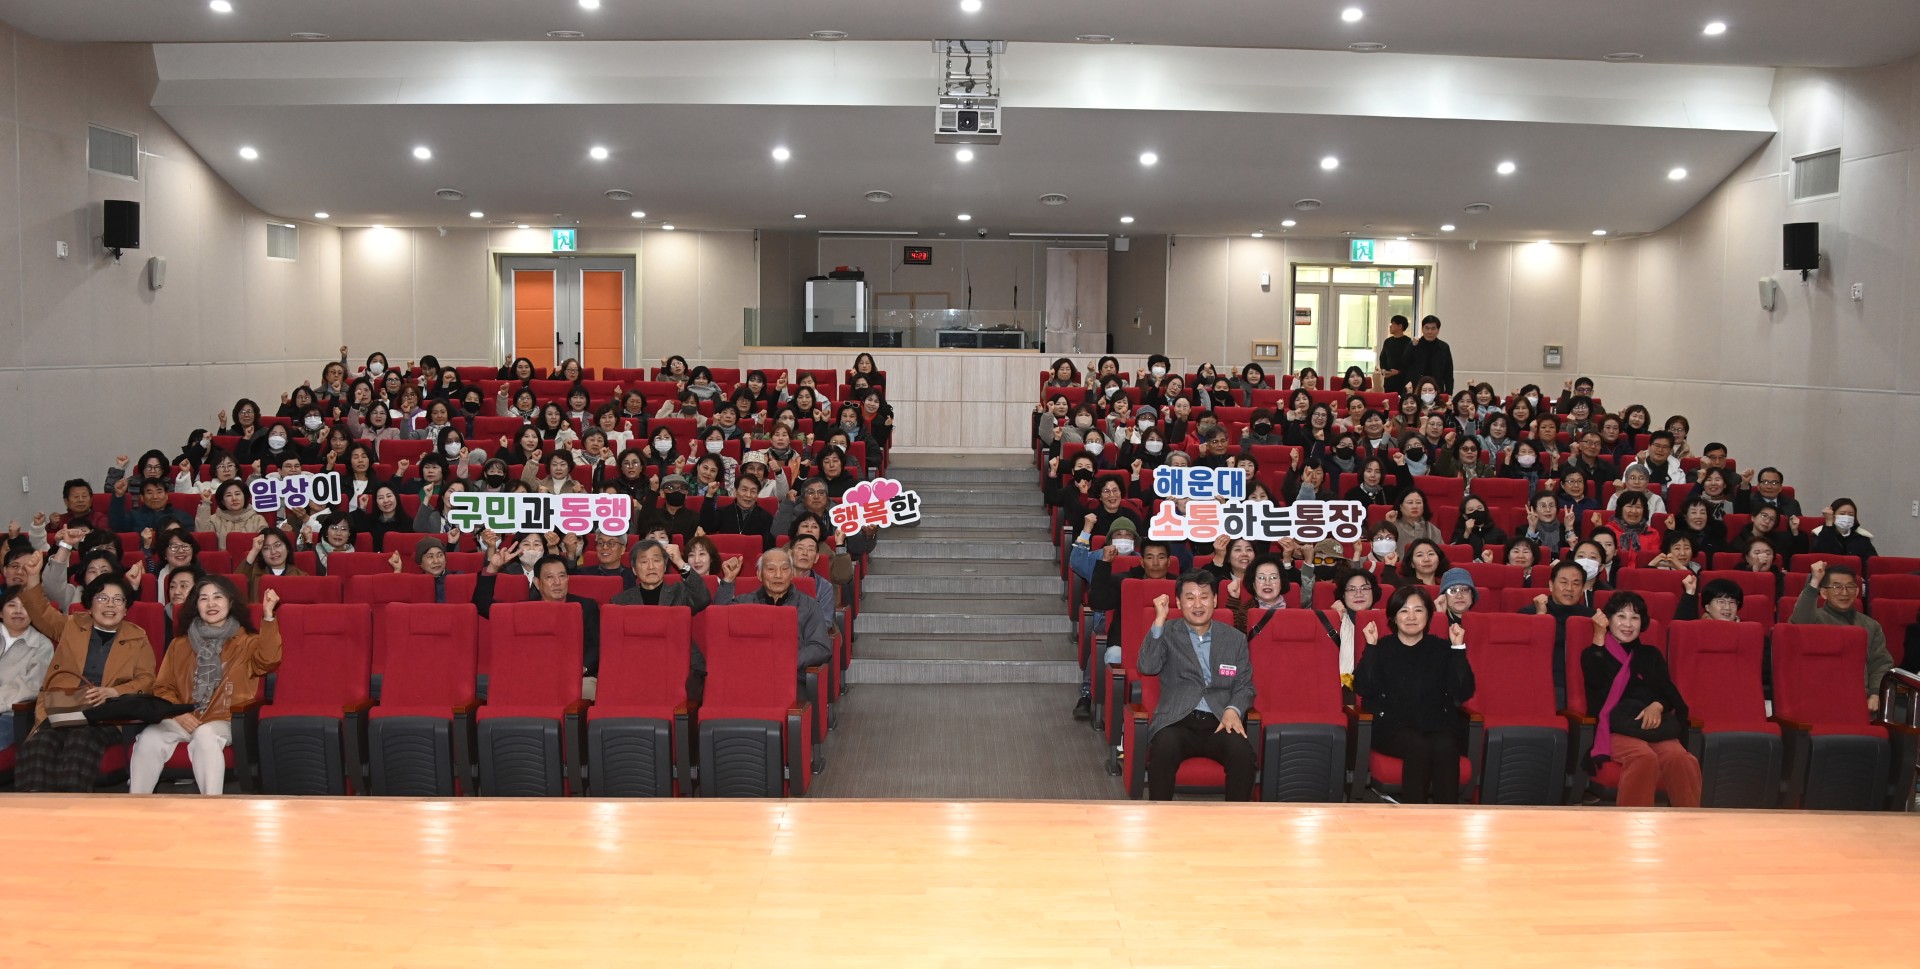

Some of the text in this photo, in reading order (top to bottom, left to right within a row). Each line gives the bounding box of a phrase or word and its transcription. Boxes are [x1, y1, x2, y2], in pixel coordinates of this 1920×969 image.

[252, 475, 338, 509] 일상이
[1156, 468, 1243, 497] 해운대
[451, 496, 627, 531] 구민과동행
[833, 493, 917, 533] 행복한
